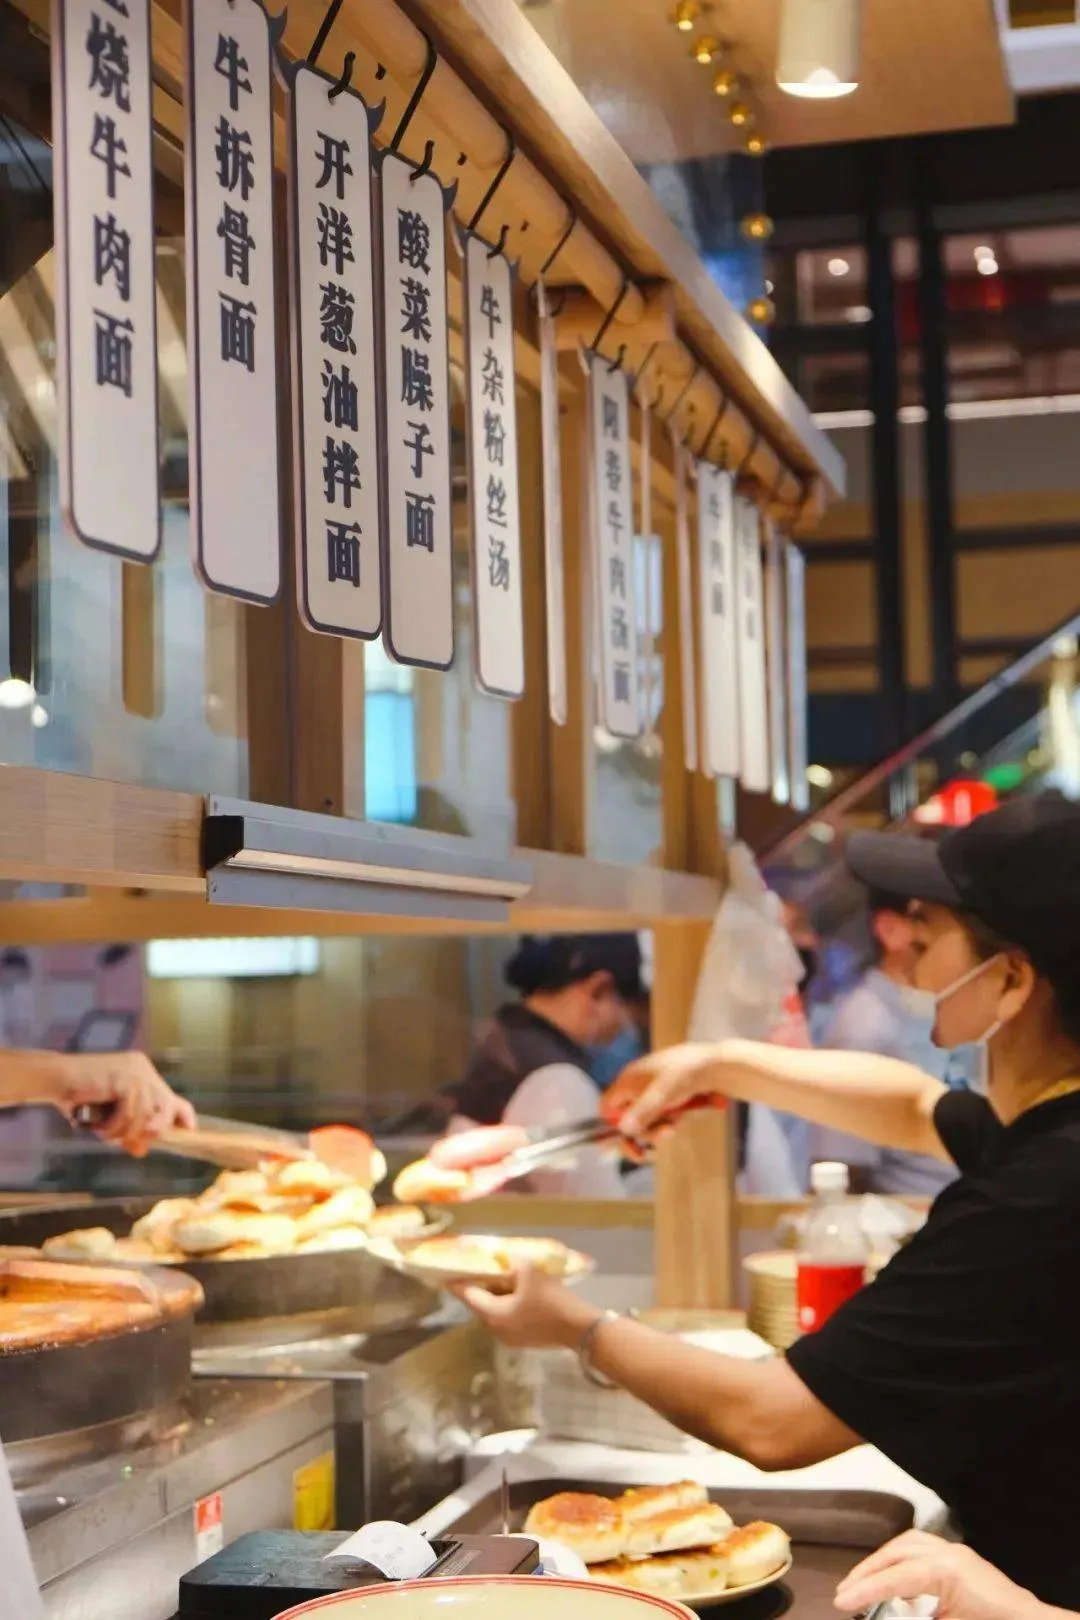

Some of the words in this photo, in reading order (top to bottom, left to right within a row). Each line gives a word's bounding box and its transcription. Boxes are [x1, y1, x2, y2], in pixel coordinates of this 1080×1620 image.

[214, 33, 257, 374] 牛拆骨面
[314, 130, 363, 589] 开洋葱油拌面
[397, 207, 435, 555] 酸菜臊子面
[480, 284, 510, 592] 牛杂粉丝汤
